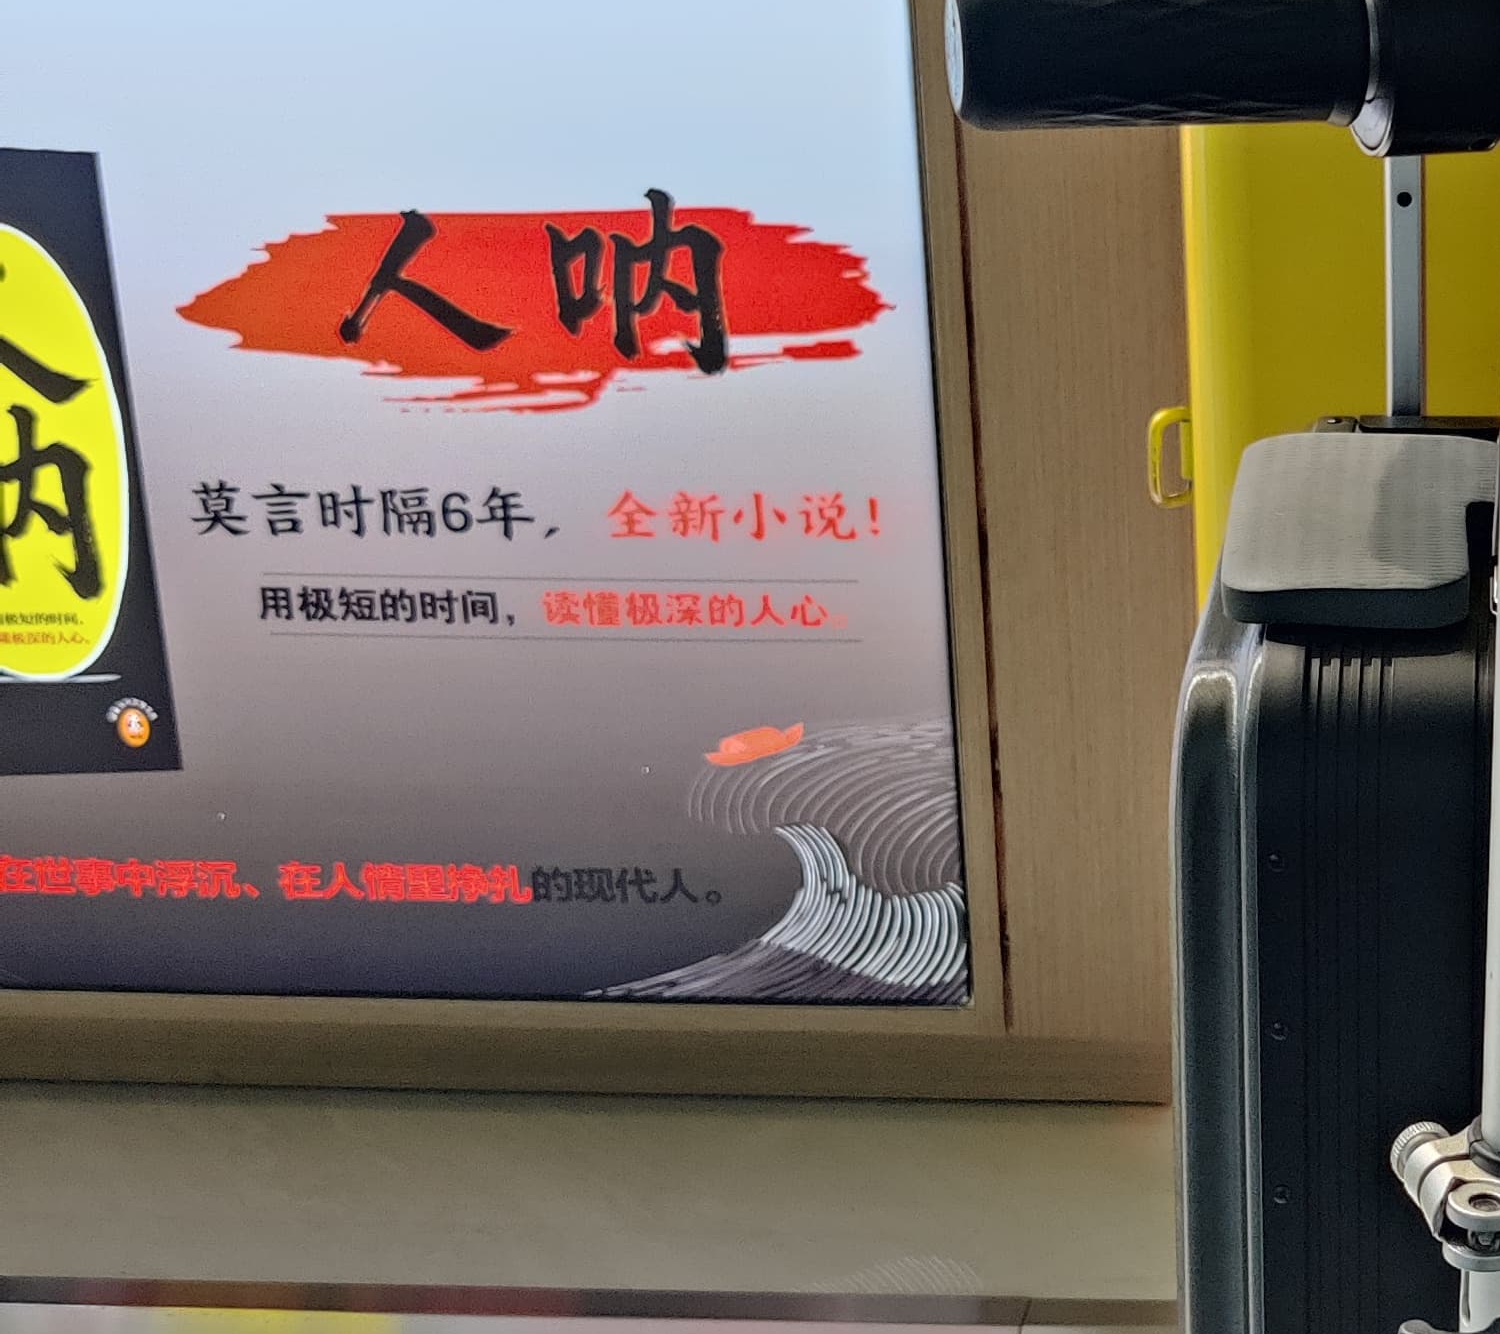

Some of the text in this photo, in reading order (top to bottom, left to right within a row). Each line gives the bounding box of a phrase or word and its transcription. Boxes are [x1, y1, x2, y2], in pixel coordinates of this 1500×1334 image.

[338, 188, 729, 376] 人呐
[190, 478, 884, 543] 莫言时隔6年，全新小说！
